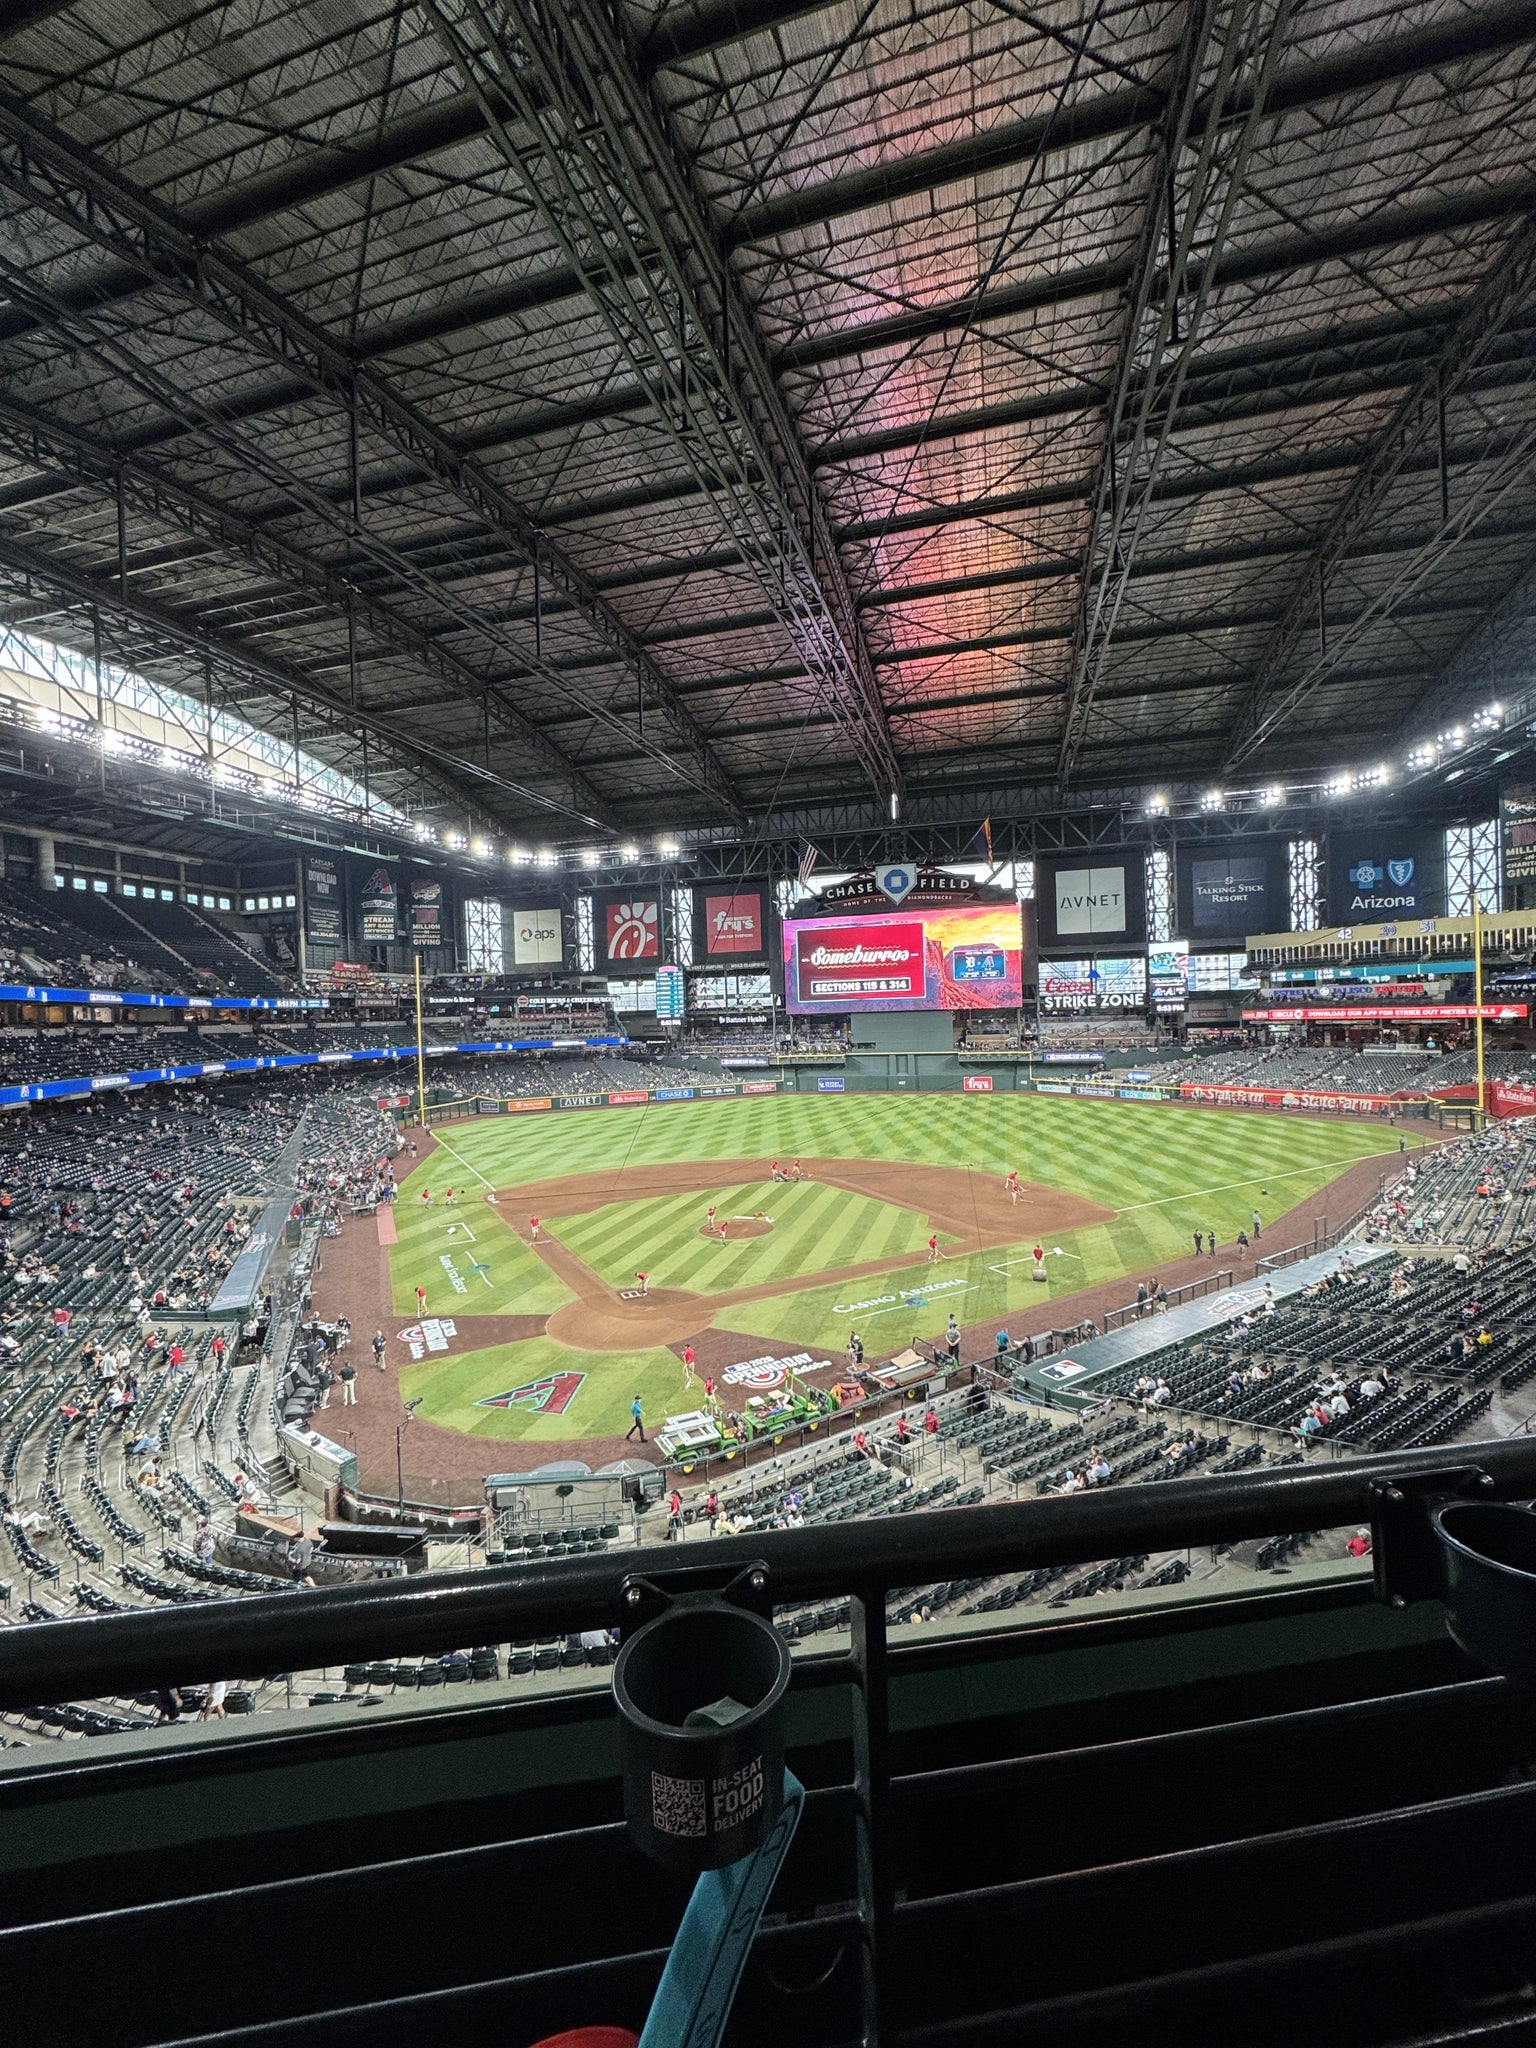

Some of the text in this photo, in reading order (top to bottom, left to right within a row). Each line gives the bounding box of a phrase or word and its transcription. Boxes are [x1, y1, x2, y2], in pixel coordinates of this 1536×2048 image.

[308, 870, 337, 885] DOWNLOAD
[317, 883, 330, 894] NOW
[826, 878, 970, 899] CHASE FIELD
[1196, 884, 1264, 896] TALKING STICK
[1060, 894, 1120, 909] AVNET
[1212, 894, 1249, 903] RESORT
[1350, 895, 1415, 909] Arizona
[713, 911, 755, 931] fry's
[534, 929, 555, 941] aps
[1337, 929, 1352, 939] 42
[811, 945, 910, 966] Someburros
[334, 971, 370, 979] SANDLOT
[815, 980, 907, 992] SECTIONS 115 & 314
[1045, 978, 1093, 994] Coors
[1273, 988, 1319, 997] ESTRELLA
[1332, 986, 1373, 994] JALISCO
[1045, 993, 1144, 1008] STRIKE ZONE
[564, 1096, 597, 1105] AVNET
[1207, 1088, 1264, 1103] State Farm
[1300, 1094, 1372, 1111] State Farm
[832, 1278, 968, 1313] CASINO ARIZONA
[721, 1352, 813, 1385] OPENING DAY
[792, 1360, 833, 1375] Adobe
[712, 1754, 763, 1793] IN-SEAT
[713, 1772, 764, 1818] FOOD
[714, 1793, 764, 1832] DELIVERY
